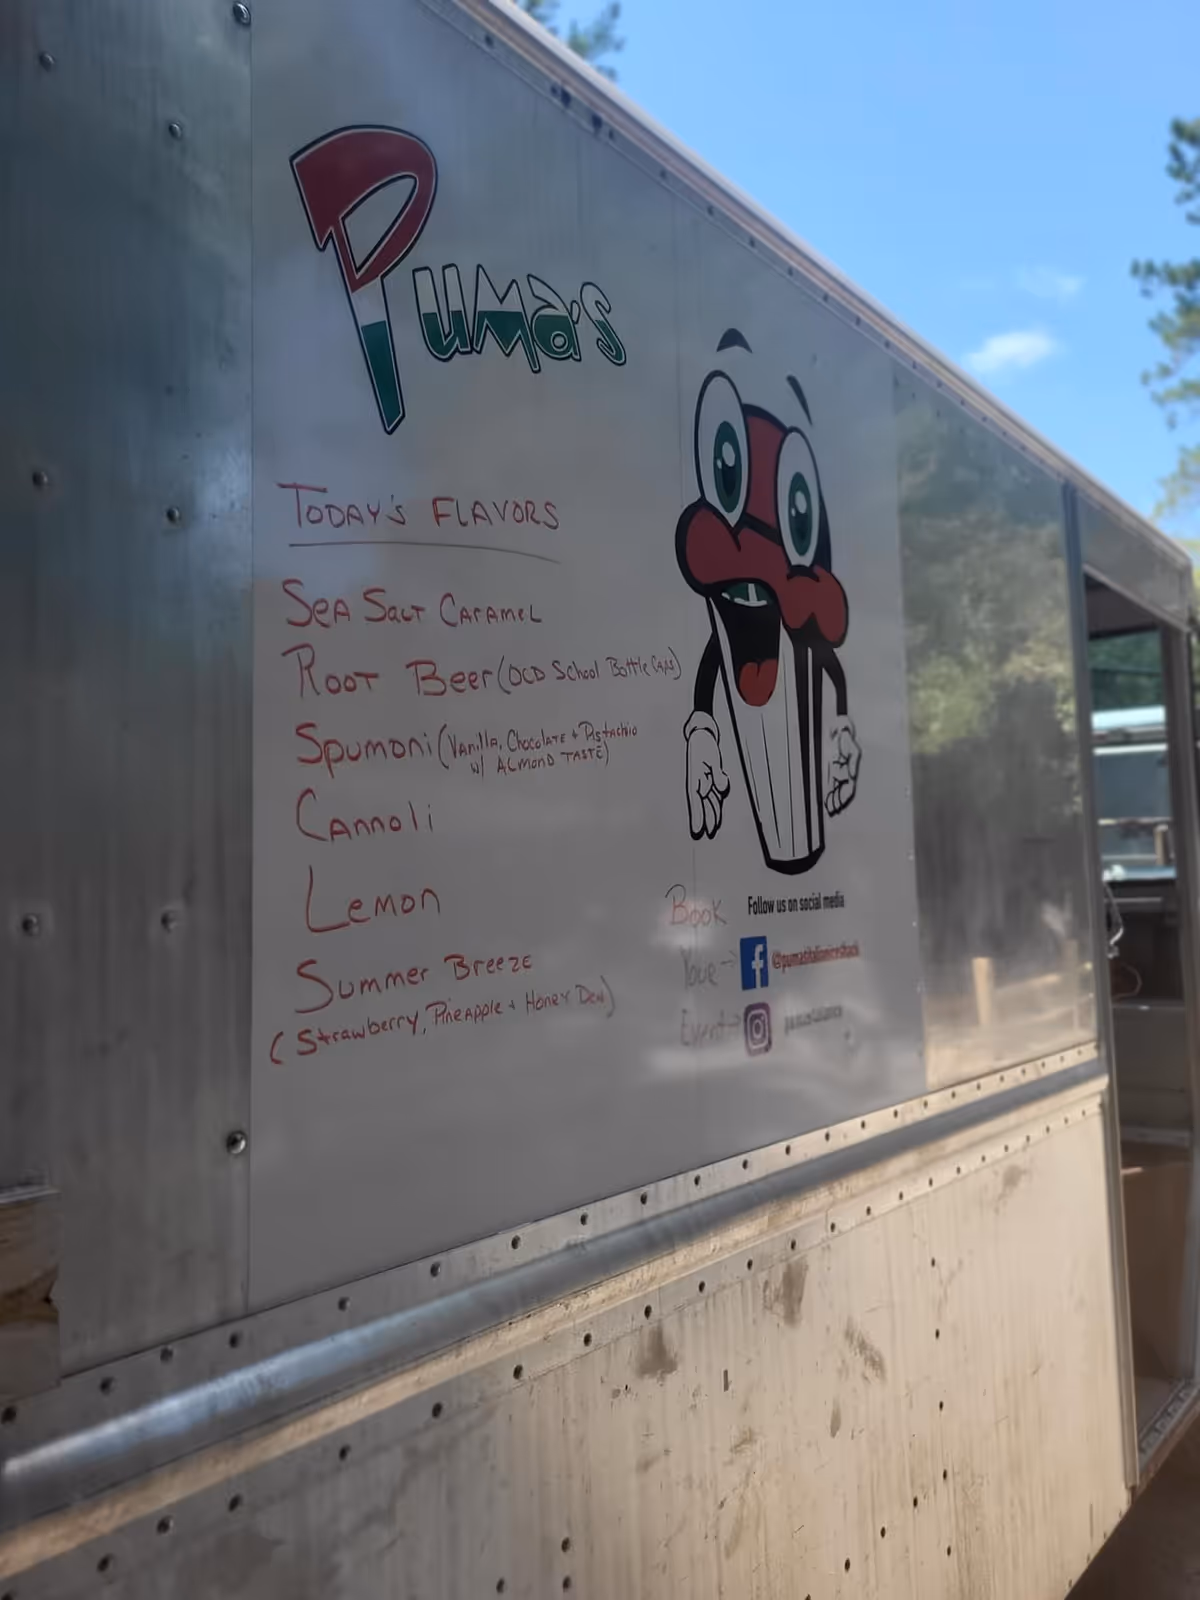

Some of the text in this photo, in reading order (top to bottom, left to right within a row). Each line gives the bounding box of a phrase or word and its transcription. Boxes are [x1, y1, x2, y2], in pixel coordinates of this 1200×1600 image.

[432, 496, 560, 530] FLAVORS
[406, 659, 493, 696] Beer
[296, 722, 433, 779] Spumoni
[747, 895, 775, 915] Follow
[776, 898, 786, 913] us
[787, 898, 798, 912] on
[799, 892, 821, 911] social
